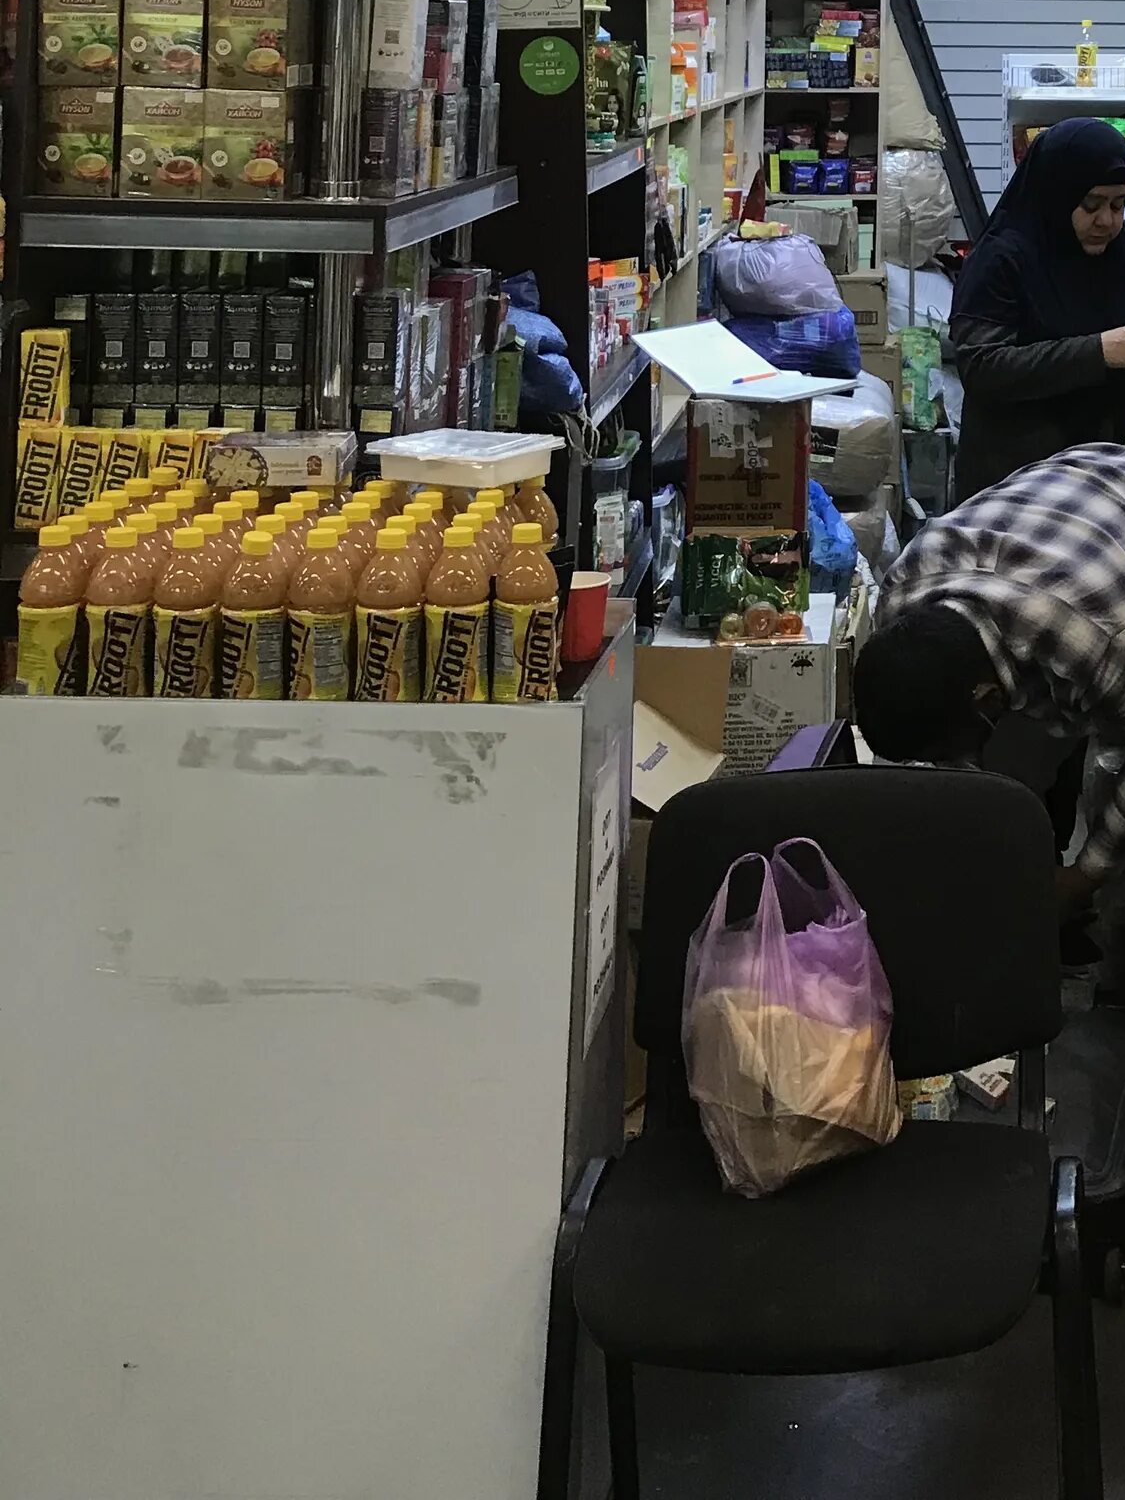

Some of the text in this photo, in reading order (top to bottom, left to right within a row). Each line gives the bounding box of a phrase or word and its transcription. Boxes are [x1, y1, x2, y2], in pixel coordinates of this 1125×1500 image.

[61, 104, 92, 113] HYSON
[146, 106, 181, 116] ХАЙСОН
[227, 108, 262, 118] ХАЙСОН
[23, 342, 61, 421] FROOTI
[18, 441, 58, 521] FROOTI
[100, 611, 138, 696] ROOTI
[170, 615, 202, 698] ROOTI
[362, 613, 400, 699] ROOTI
